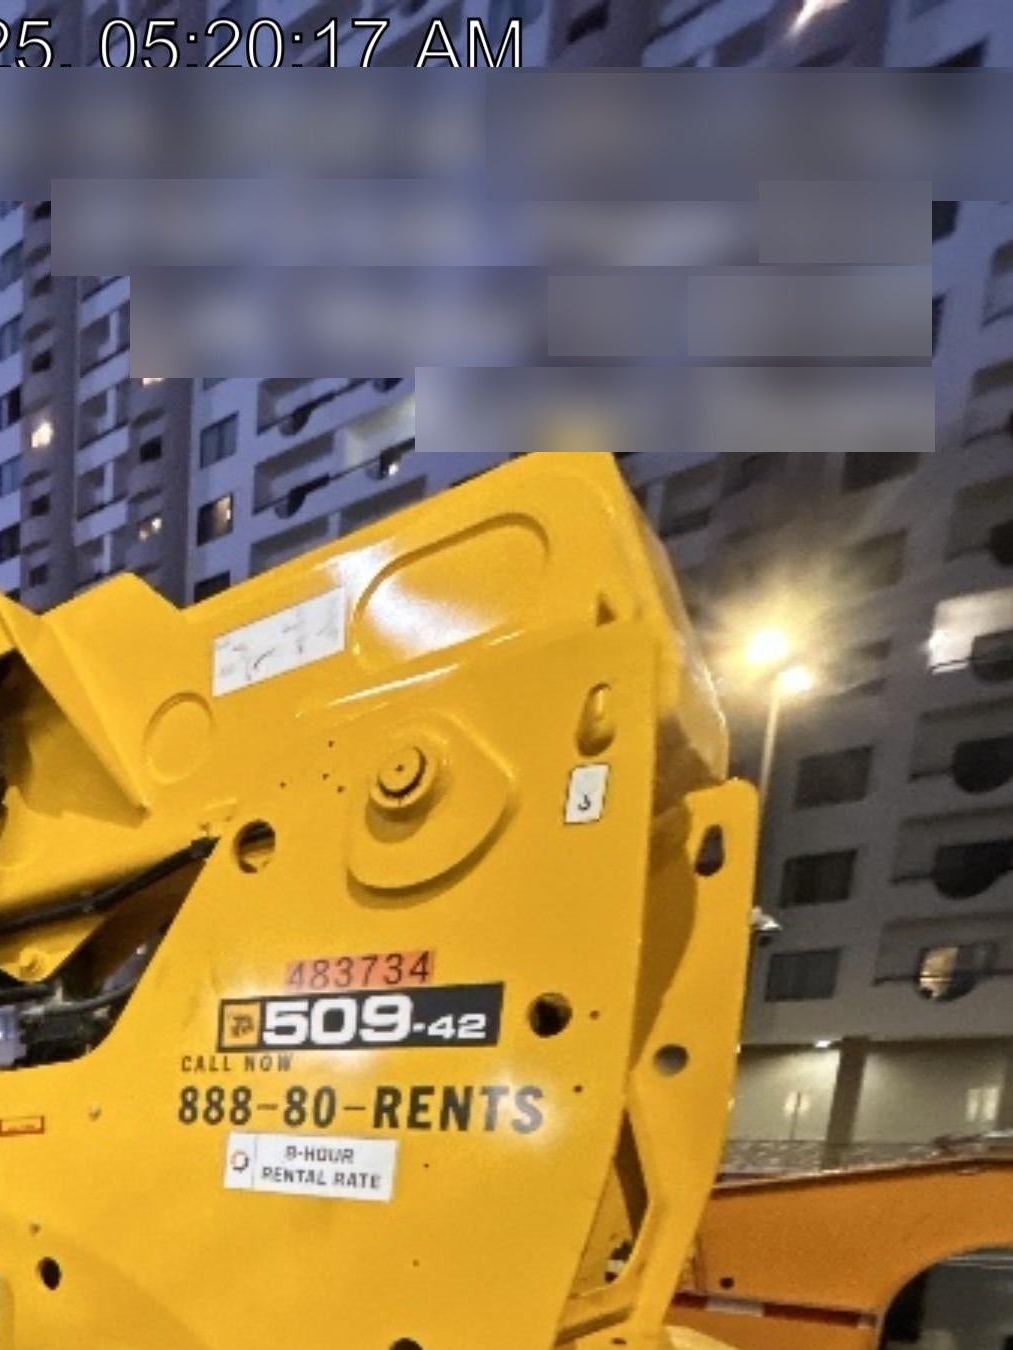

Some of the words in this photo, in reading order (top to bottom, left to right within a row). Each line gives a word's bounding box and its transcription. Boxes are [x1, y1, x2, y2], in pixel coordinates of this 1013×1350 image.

[287, 951, 431, 989] 483734
[262, 995, 487, 1046] 509-42
[180, 1055, 232, 1073] CALL
[243, 1053, 294, 1073] NOW
[177, 1085, 544, 1132] 888-80-RENTS
[284, 1144, 355, 1164] 8-HOUR
[261, 1166, 327, 1186] RENTAL
[332, 1171, 381, 1190] RATE
